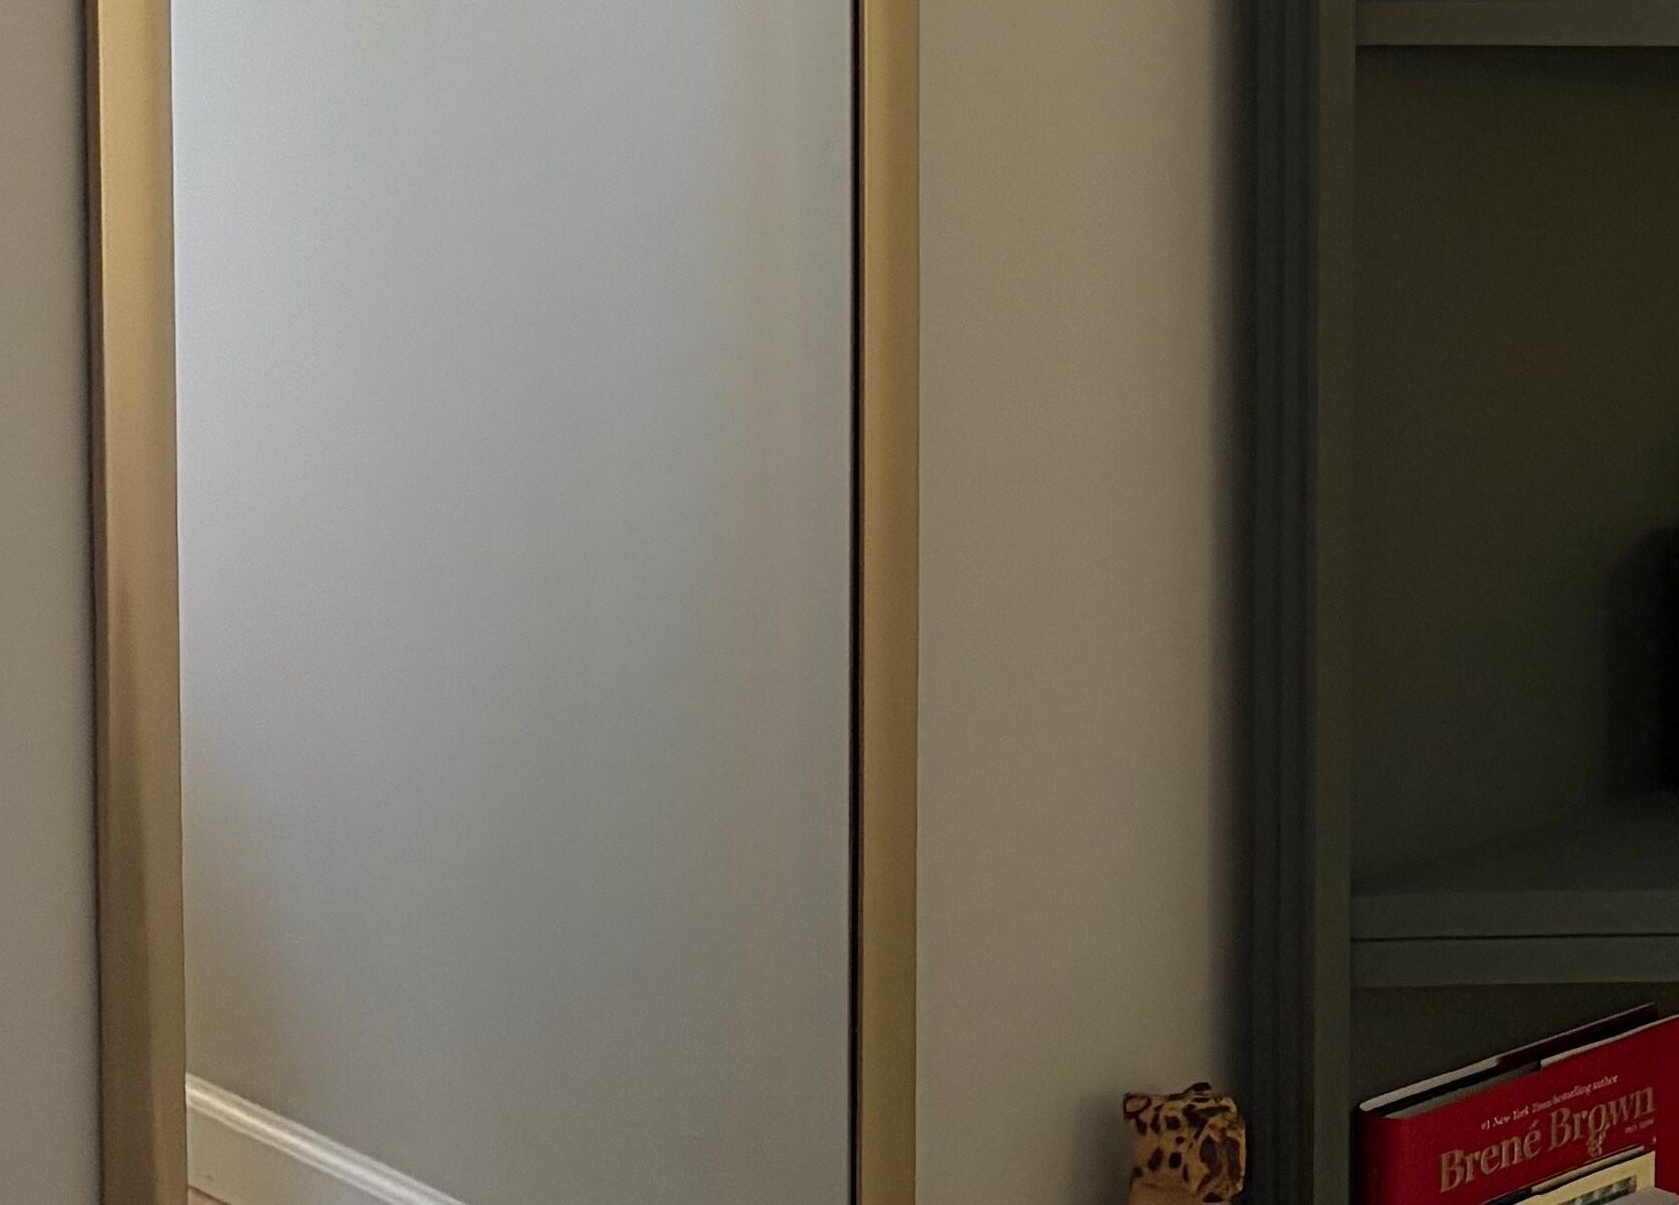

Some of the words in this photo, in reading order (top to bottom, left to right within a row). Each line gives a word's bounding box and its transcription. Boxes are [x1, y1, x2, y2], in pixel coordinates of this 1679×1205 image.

[1439, 1119, 1543, 1194] Brené
[1548, 1085, 1657, 1153] Brown
[1492, 1116, 1511, 1128] New
[1513, 1108, 1530, 1121] York
